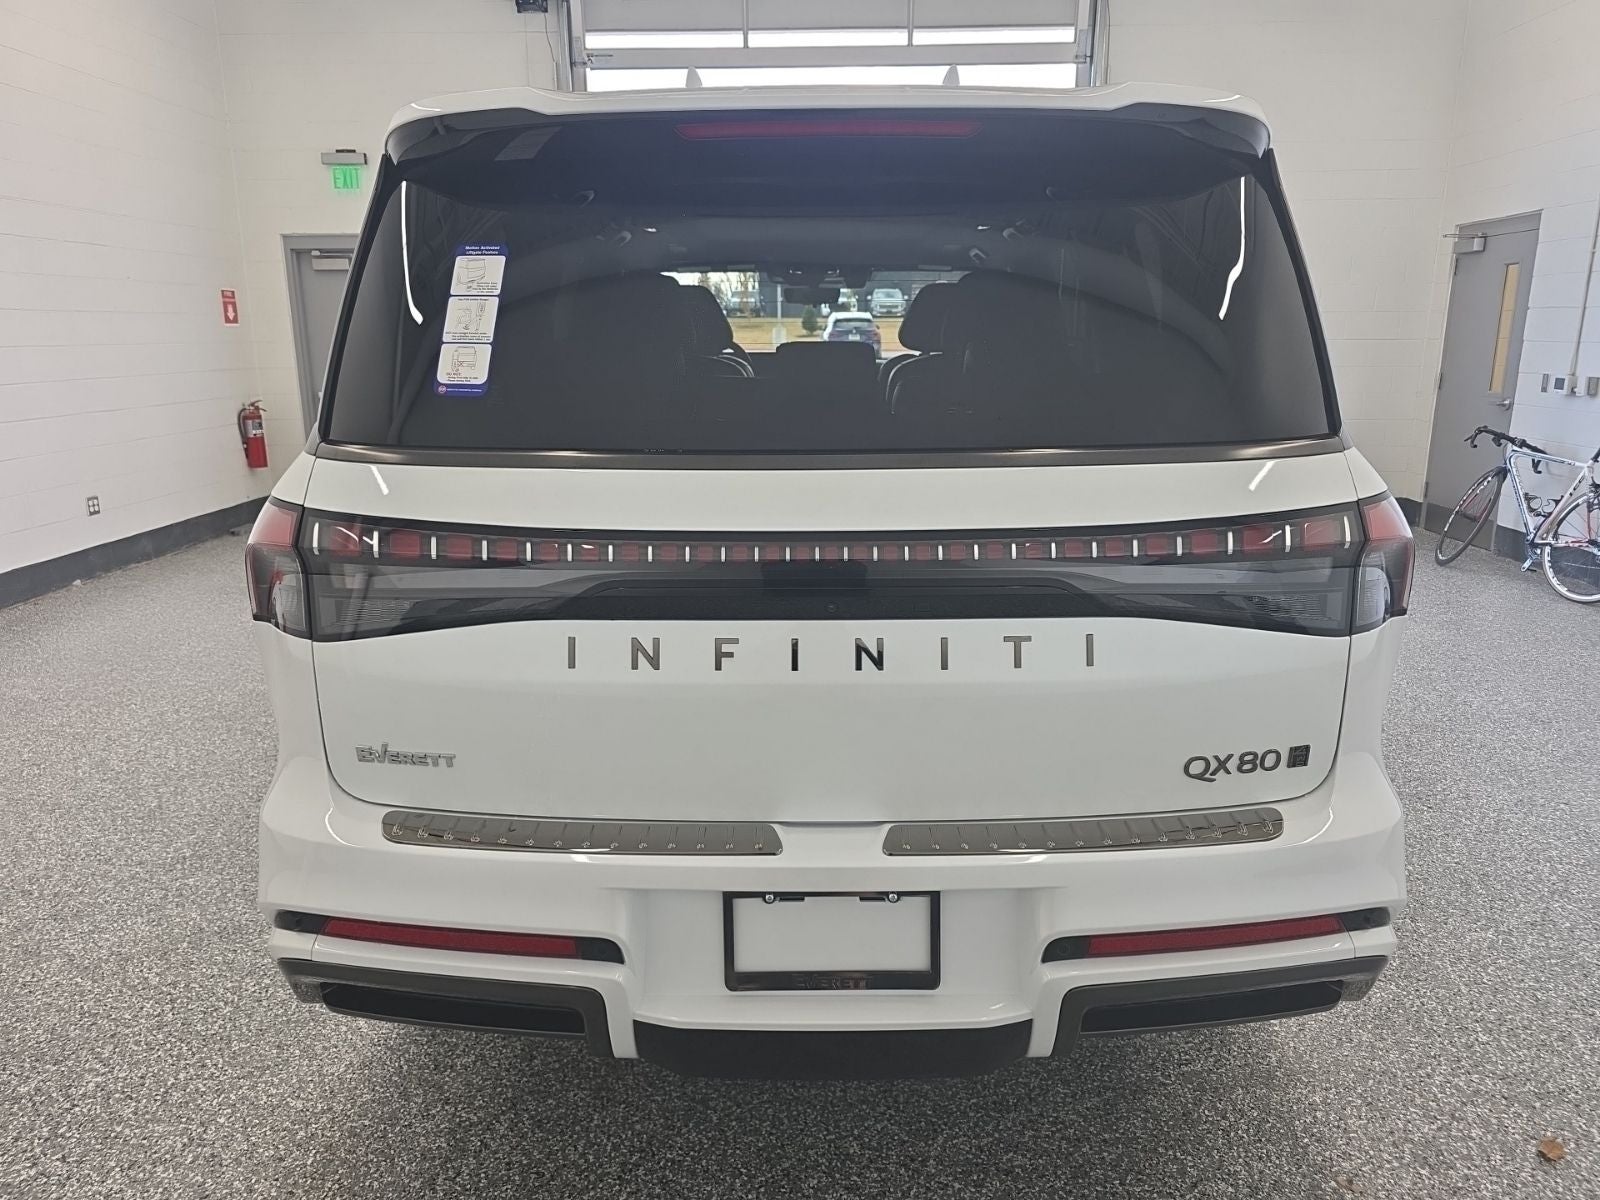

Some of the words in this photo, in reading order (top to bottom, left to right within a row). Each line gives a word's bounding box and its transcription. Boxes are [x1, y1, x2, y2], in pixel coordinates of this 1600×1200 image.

[333, 168, 360, 189] EXIT
[567, 633, 1095, 671] INFINITI
[1184, 748, 1282, 782] QX80
